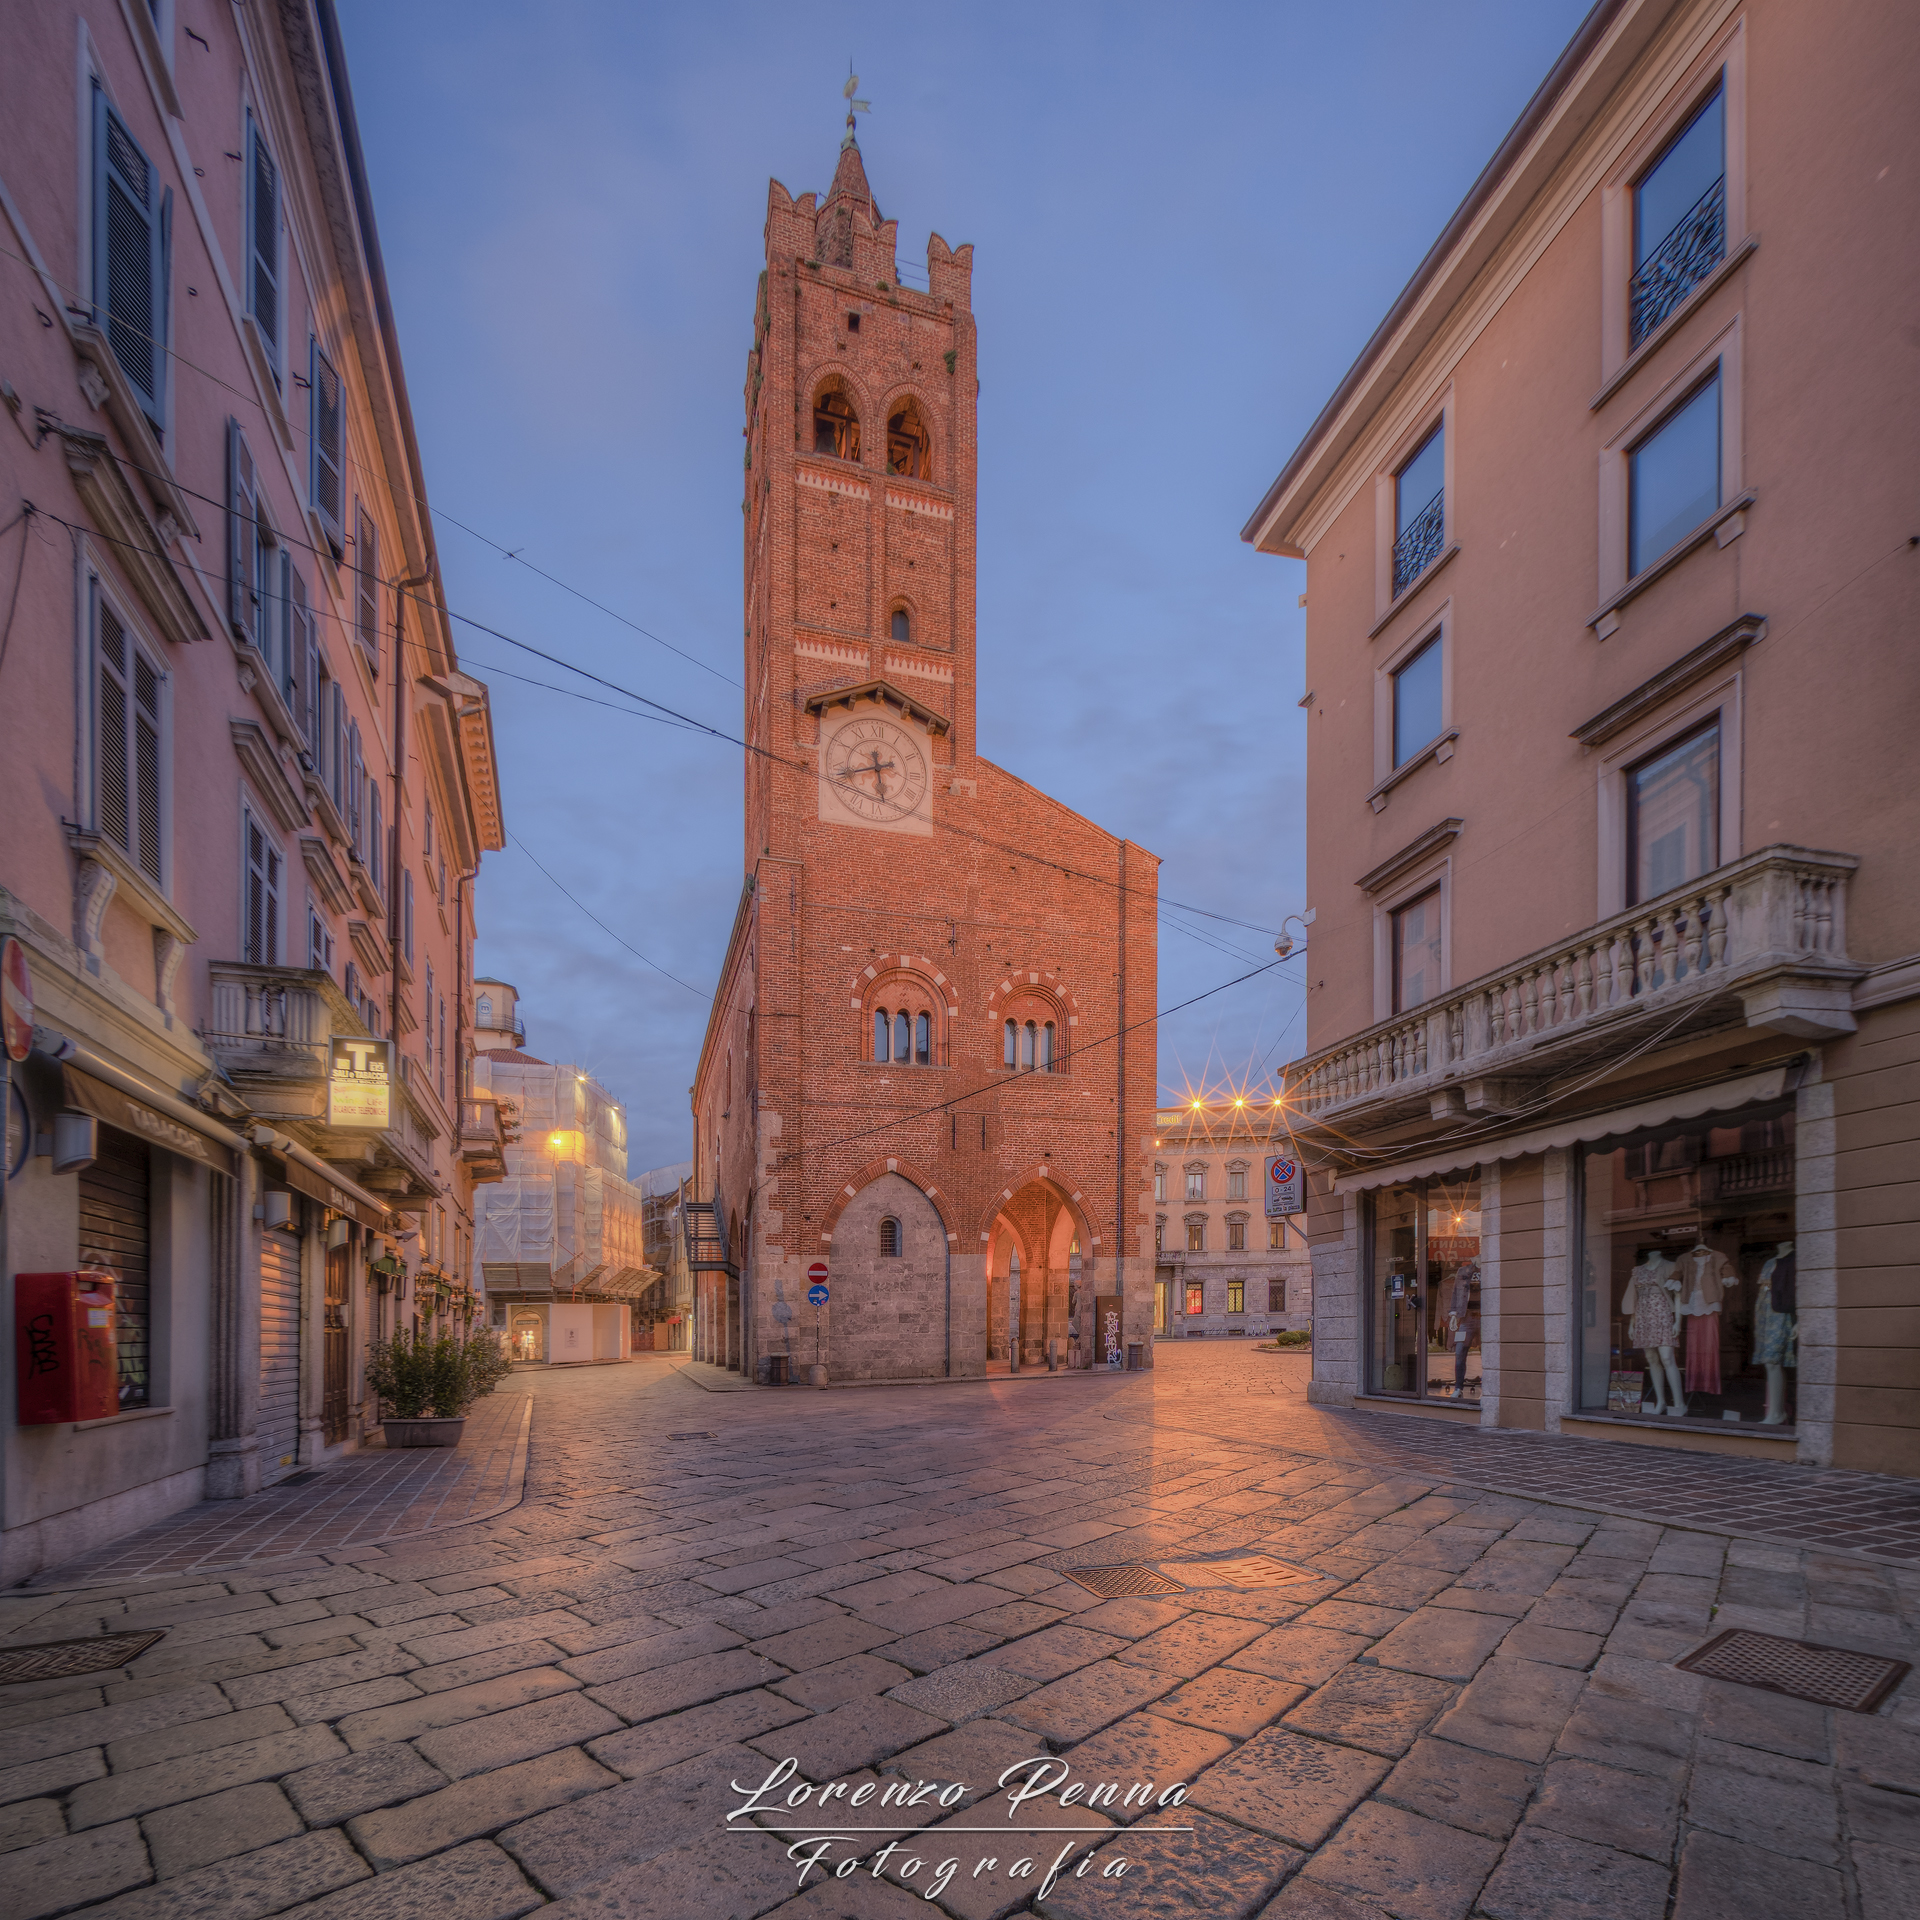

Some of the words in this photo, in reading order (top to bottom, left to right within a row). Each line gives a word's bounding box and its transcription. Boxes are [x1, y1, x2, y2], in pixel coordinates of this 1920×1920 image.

[345, 1043, 376, 1070] T
[332, 1069, 349, 1078] SALI
[355, 1070, 389, 1080] TABACCHI
[126, 1102, 208, 1155] TABACCHI
